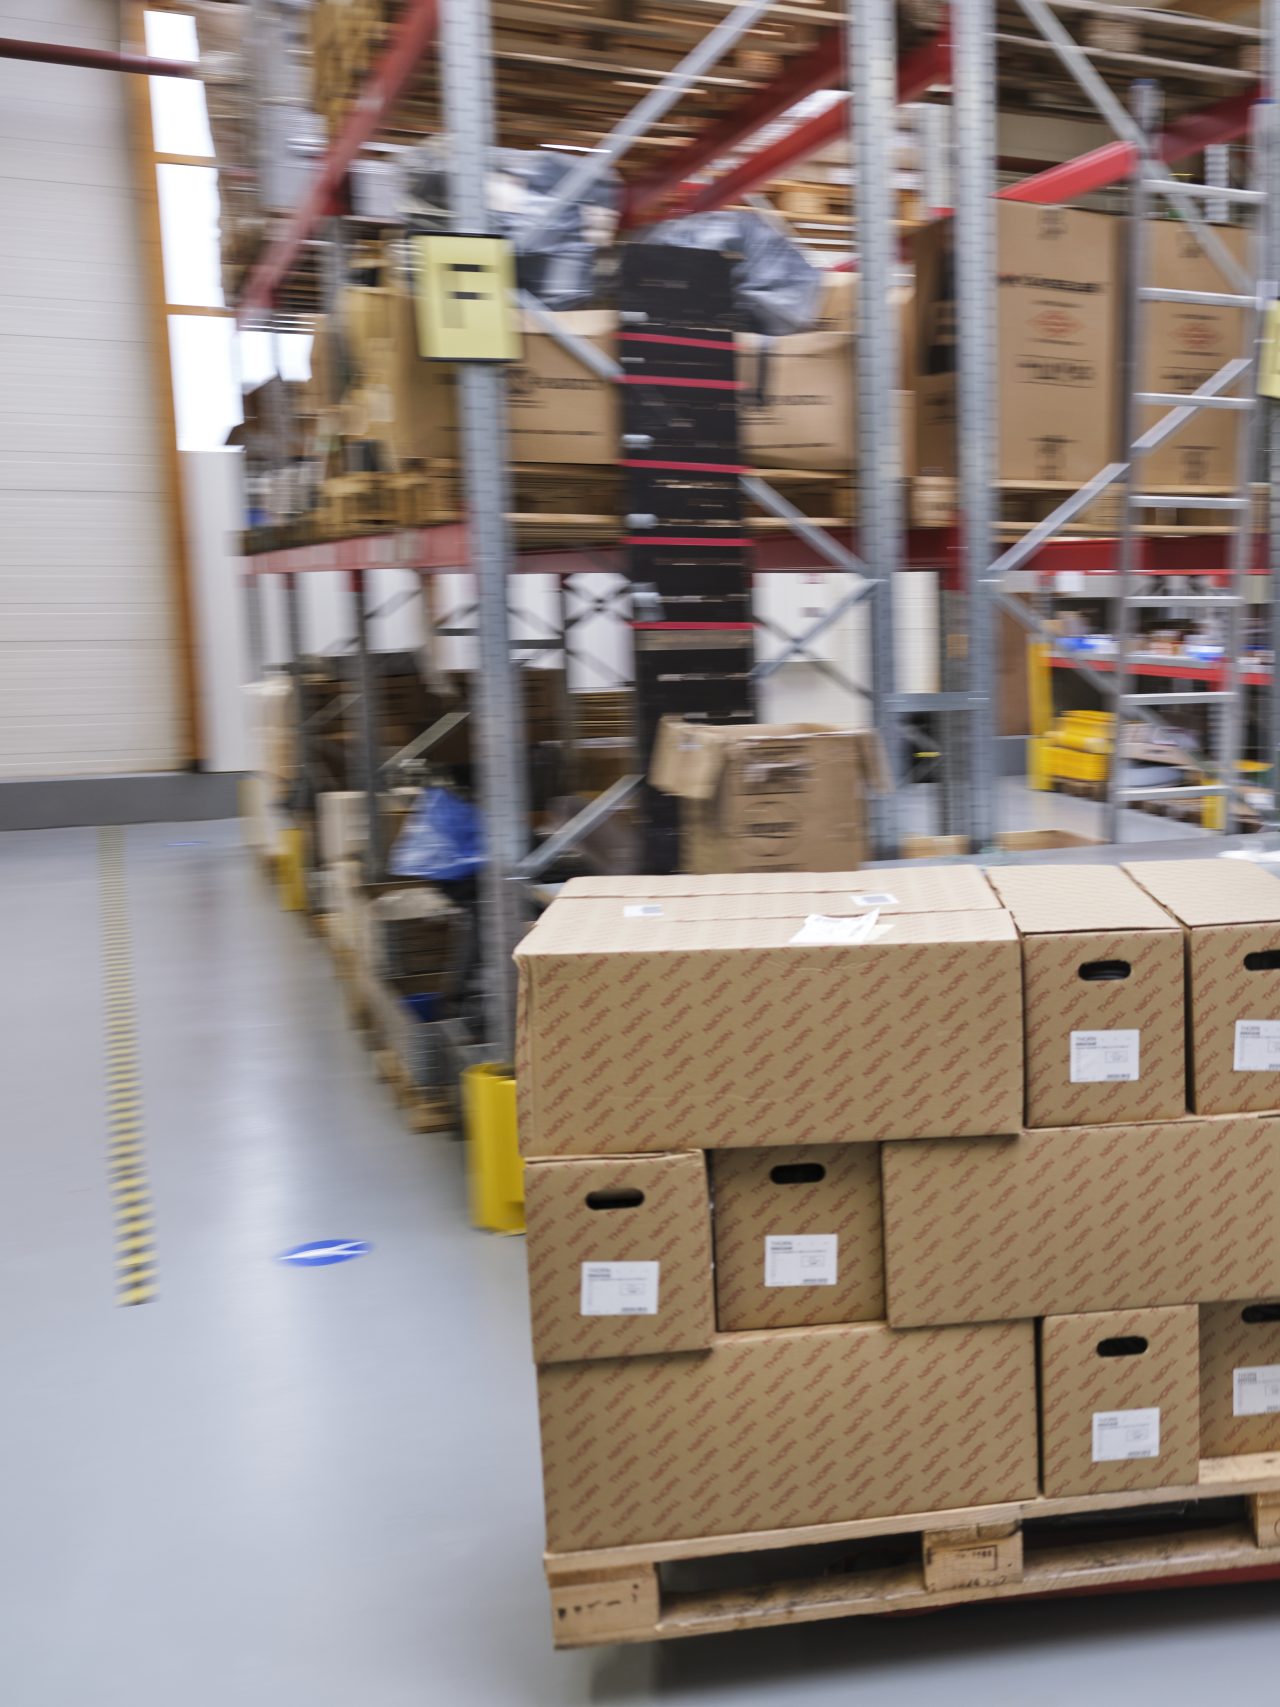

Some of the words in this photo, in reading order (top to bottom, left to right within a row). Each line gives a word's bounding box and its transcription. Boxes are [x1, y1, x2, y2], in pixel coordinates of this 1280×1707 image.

[440, 262, 496, 329] F
[619, 958, 650, 985] THORN
[700, 954, 731, 983] THORN
[578, 982, 610, 1011] THORN
[660, 980, 692, 1009] THORN
[701, 978, 733, 1007] THORN
[741, 977, 773, 1005] THORN
[820, 974, 851, 1003] THORN
[938, 970, 969, 999] THORN
[976, 969, 1007, 997] THORN
[661, 1003, 693, 1032] THORN
[701, 1005, 733, 1034] THORN
[742, 1000, 774, 1029] THORN
[781, 1002, 813, 1031] THORN
[821, 997, 852, 1026] THORN
[860, 1000, 891, 1028] THORN
[899, 995, 930, 1023] THORN
[938, 997, 969, 1025] THORN
[977, 992, 1008, 1020] THORN
[539, 1010, 571, 1039] THORN
[620, 1008, 652, 1037] THORN
[939, 1020, 970, 1048] THORN
[541, 1034, 572, 1063] THORN
[580, 1033, 613, 1062] THORN
[783, 1026, 814, 1054] THORN
[821, 1024, 853, 1053] THORN
[861, 1023, 892, 1051] THORN
[581, 1057, 613, 1085] THORN
[662, 1054, 695, 1083] THORN
[703, 1056, 735, 1084] THORN
[744, 1051, 775, 1080] THORN
[783, 1053, 814, 1081] THORN
[822, 1048, 854, 1077] THORN
[861, 1050, 893, 1078] THORN
[901, 1044, 932, 1073] THORN
[939, 1046, 970, 1074] THORN
[622, 1059, 654, 1087] THORN
[584, 1106, 615, 1135] THORN
[624, 1108, 656, 1136] THORN
[665, 1103, 696, 1131] THORN
[705, 1104, 736, 1132] THORN
[784, 1101, 816, 1128] THORN
[824, 1096, 855, 1124] THORN
[863, 1097, 894, 1125] THORN
[543, 1111, 574, 1139] THORN
[1062, 1156, 1091, 1183] THORN
[1136, 1150, 1165, 1178] THORN
[1209, 1145, 1237, 1173] THORN
[987, 1161, 1016, 1189] THORN
[1136, 1173, 1165, 1200] THORN
[1174, 1173, 1202, 1200] THORN
[1246, 1168, 1273, 1195] THORN
[950, 1190, 980, 1216] THORN
[1026, 1184, 1056, 1211] THORN
[1063, 1178, 1092, 1205] THORN
[1100, 1178, 1129, 1207] THORN
[1210, 1192, 1238, 1219] THORN
[989, 1209, 1019, 1237] THORN
[1137, 1198, 1166, 1226] THORN
[912, 1215, 942, 1243] THORN
[1064, 1225, 1093, 1252] THORN
[1101, 1226, 1130, 1253] THORN
[1175, 1220, 1203, 1246] THORN
[1246, 1214, 1274, 1241] THORN
[952, 1237, 981, 1265] THORN
[1027, 1232, 1056, 1259] THORN
[1138, 1245, 1166, 1272] THORN
[1210, 1238, 1238, 1266] THORN
[1247, 1236, 1274, 1264] THORN
[990, 1257, 1019, 1284] THORN
[1102, 1248, 1131, 1275] THORN
[1210, 1258, 1238, 1285] THORN
[1246, 1258, 1273, 1284] THORN
[1029, 1277, 1057, 1302] THORN
[1102, 1271, 1130, 1297] THORN
[1175, 1265, 1202, 1291] THORN
[953, 1283, 983, 1309] THORN
[841, 1360, 871, 1388] THORN
[955, 1348, 984, 1376] THORN
[645, 1380, 675, 1408] THORN
[764, 1367, 794, 1396] THORN
[881, 1381, 910, 1410] THORN
[687, 1398, 717, 1427] THORN
[726, 1397, 756, 1426] THORN
[804, 1389, 834, 1418] THORN
[957, 1395, 986, 1423] THORN
[565, 1413, 596, 1441] THORN
[646, 1405, 677, 1434] THORN
[766, 1417, 796, 1445] THORN
[843, 1408, 873, 1436] THORN
[957, 1419, 987, 1448] THORN
[607, 1432, 637, 1461] THORN
[728, 1420, 758, 1449] THORN
[882, 1428, 912, 1456] THORN
[728, 1446, 758, 1473] THORN
[806, 1438, 836, 1465] THORN
[958, 1441, 987, 1469] THORN
[994, 1436, 1023, 1465] THORN
[568, 1462, 598, 1489] THORN
[649, 1454, 679, 1482] THORN
[807, 1460, 837, 1488] THORN
[883, 1451, 913, 1479] THORN
[959, 1465, 988, 1492] THORN
[650, 1476, 681, 1505] THORN
[884, 1474, 913, 1501] THORN
[730, 1492, 760, 1518] THORN
[571, 1508, 601, 1535] THORN
